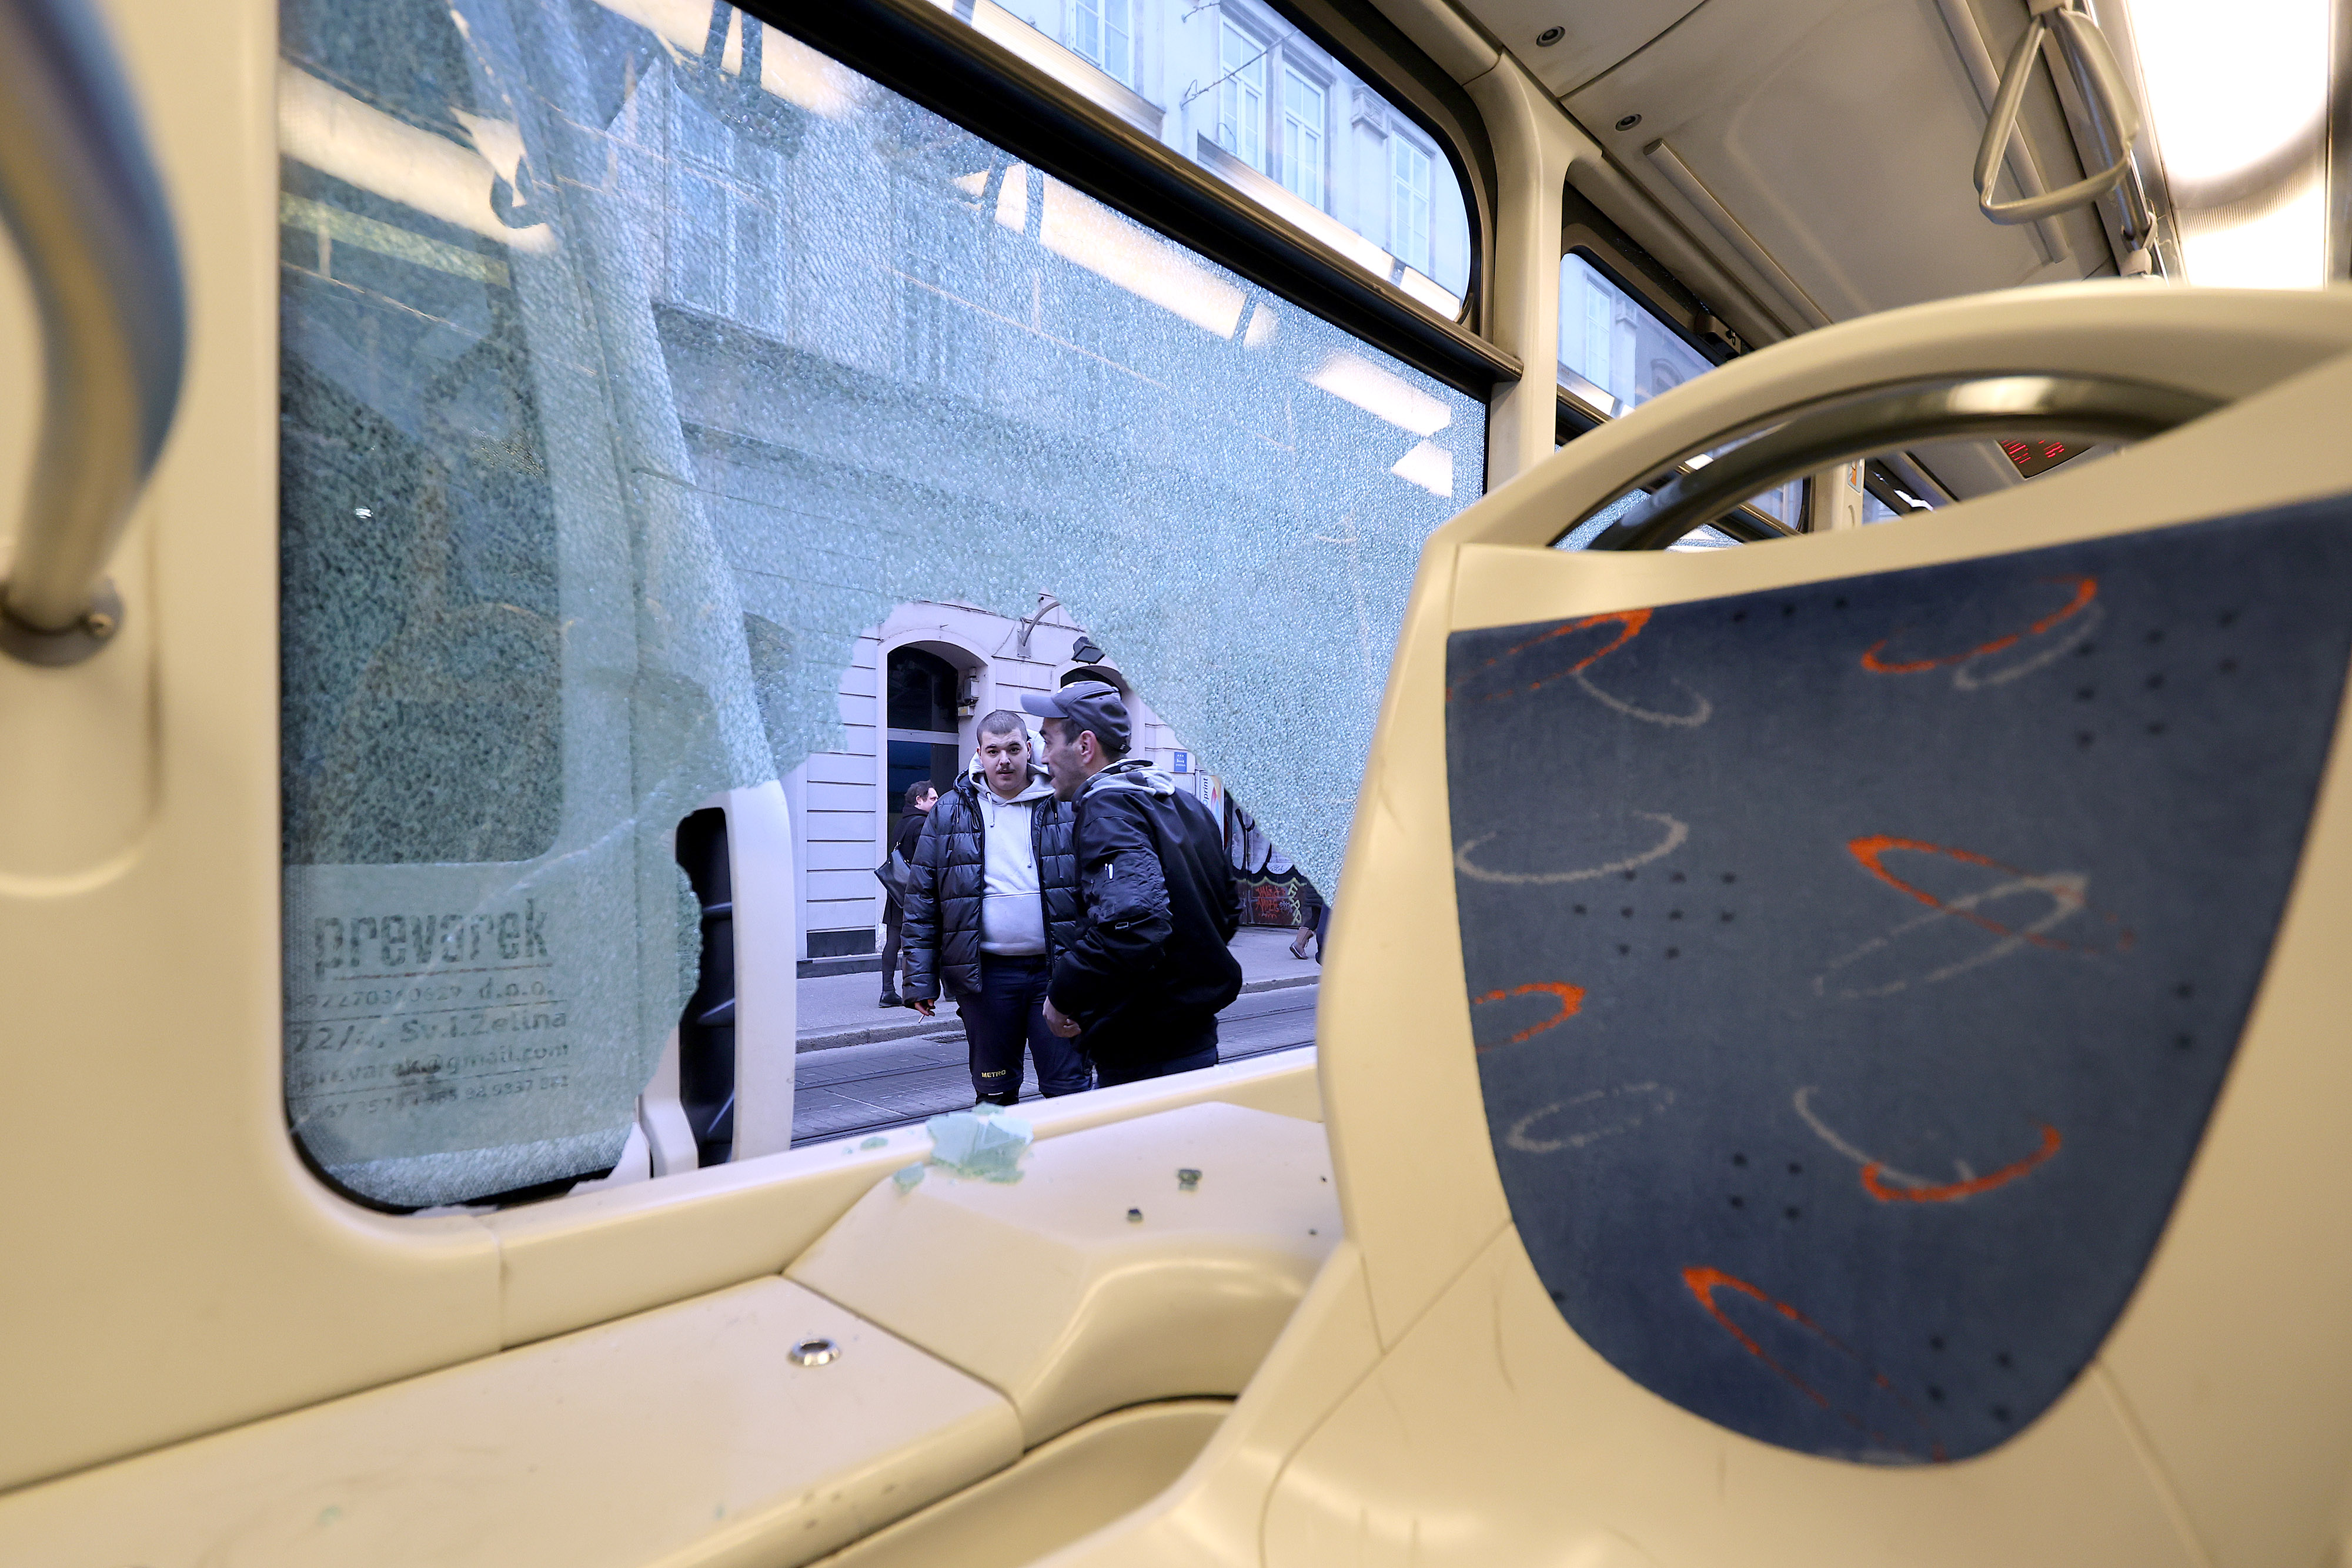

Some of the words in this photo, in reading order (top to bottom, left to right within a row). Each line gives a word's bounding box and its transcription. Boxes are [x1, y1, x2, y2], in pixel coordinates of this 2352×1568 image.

[314, 898, 548, 982] prevarek
[479, 977, 555, 999] d.o.o.
[981, 1069, 1006, 1078] METRO
